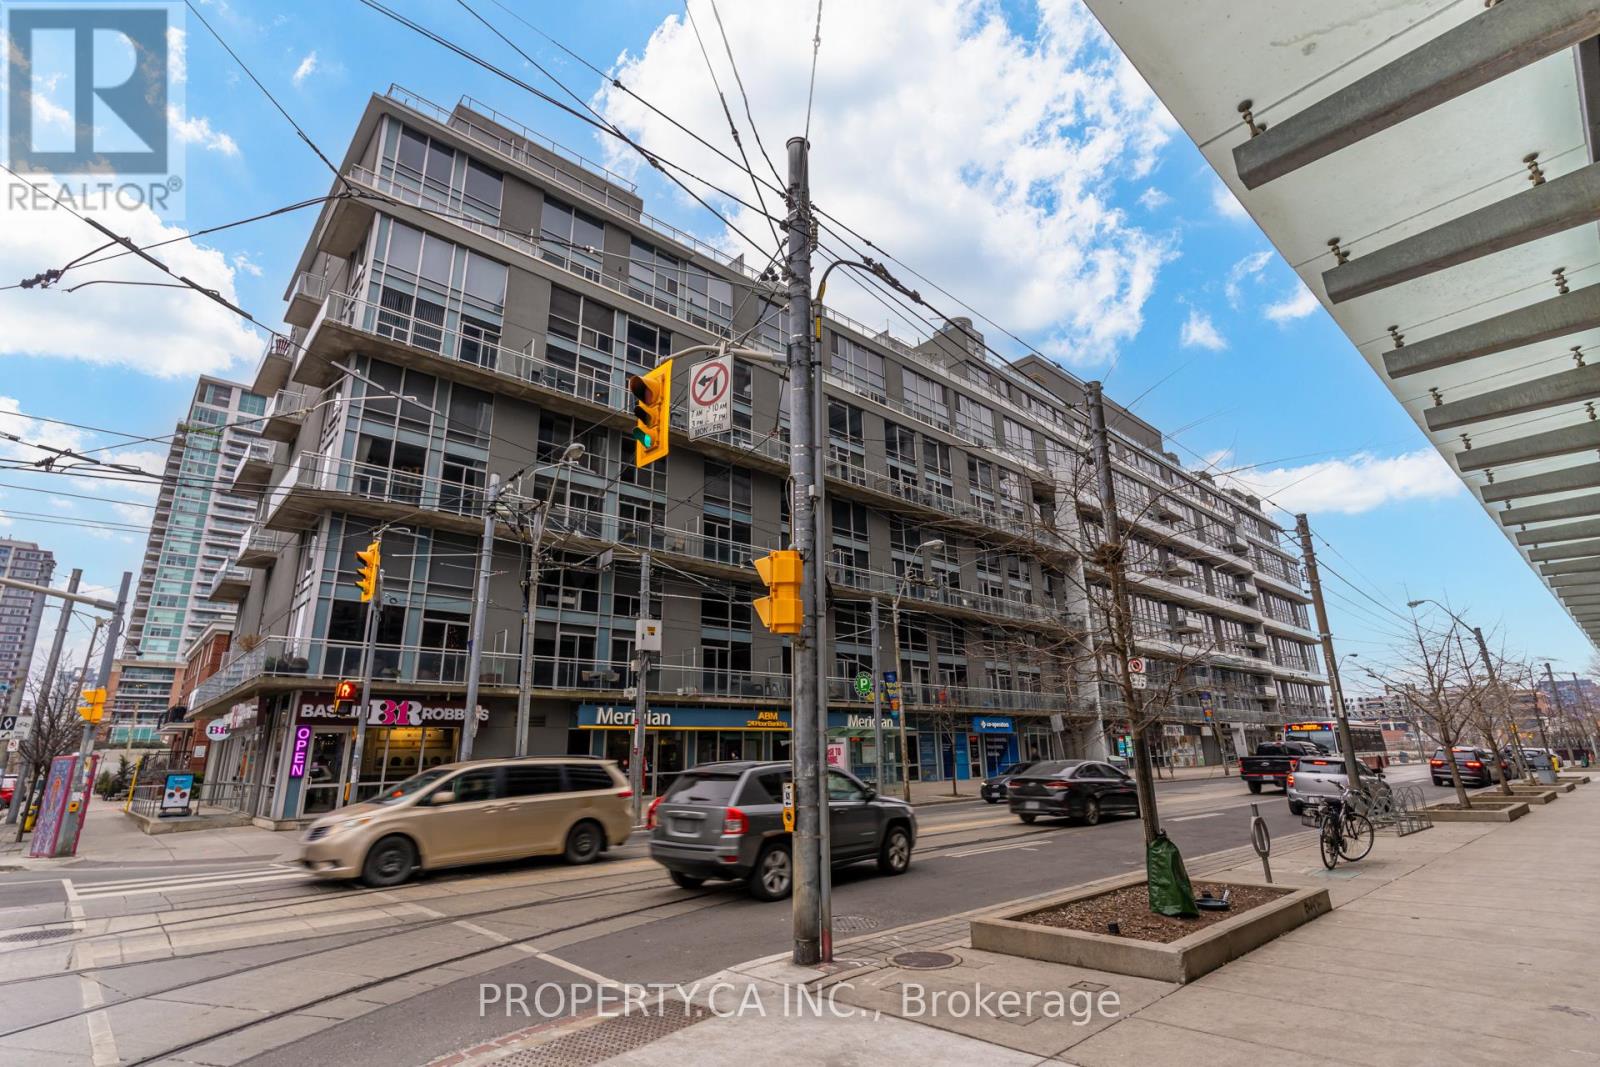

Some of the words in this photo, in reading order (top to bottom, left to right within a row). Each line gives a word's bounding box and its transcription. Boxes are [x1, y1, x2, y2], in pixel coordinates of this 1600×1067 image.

[712, 403, 719, 412] 10
[720, 402, 727, 410] AM
[695, 427, 708, 435] MON
[713, 423, 723, 431] FRI
[421, 706, 489, 721] ROBBS
[596, 707, 671, 726] Meriian
[758, 711, 778, 721] ABM
[291, 728, 310, 777] OPEN
